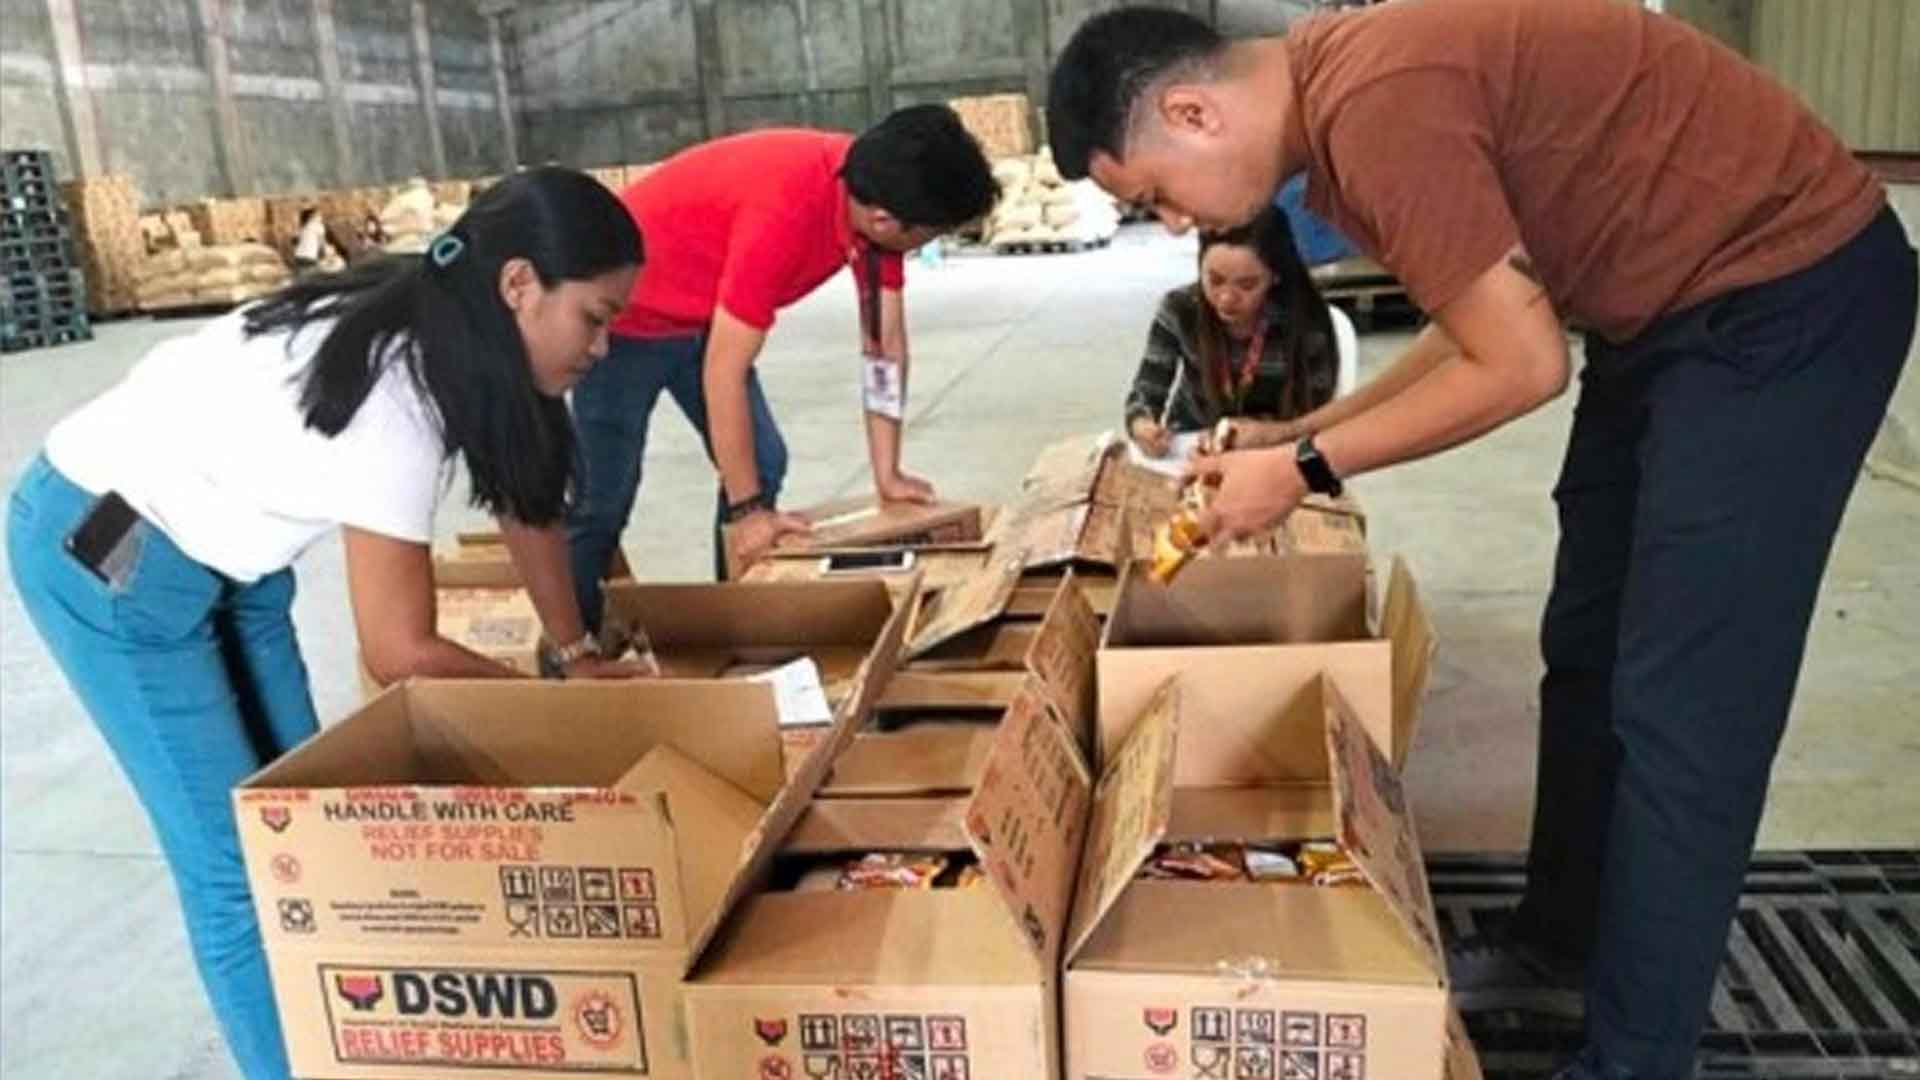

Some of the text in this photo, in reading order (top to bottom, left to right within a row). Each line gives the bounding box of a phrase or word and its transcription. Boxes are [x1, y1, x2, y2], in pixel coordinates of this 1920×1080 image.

[323, 801, 575, 822] HANDLE WITH CARE
[361, 824, 543, 841] RELIEF SUPPLIES
[371, 843, 540, 861] NOT FOR SALE
[392, 973, 557, 1018] DSWD
[341, 1028, 566, 1061] RELIEF SUPPLIES
